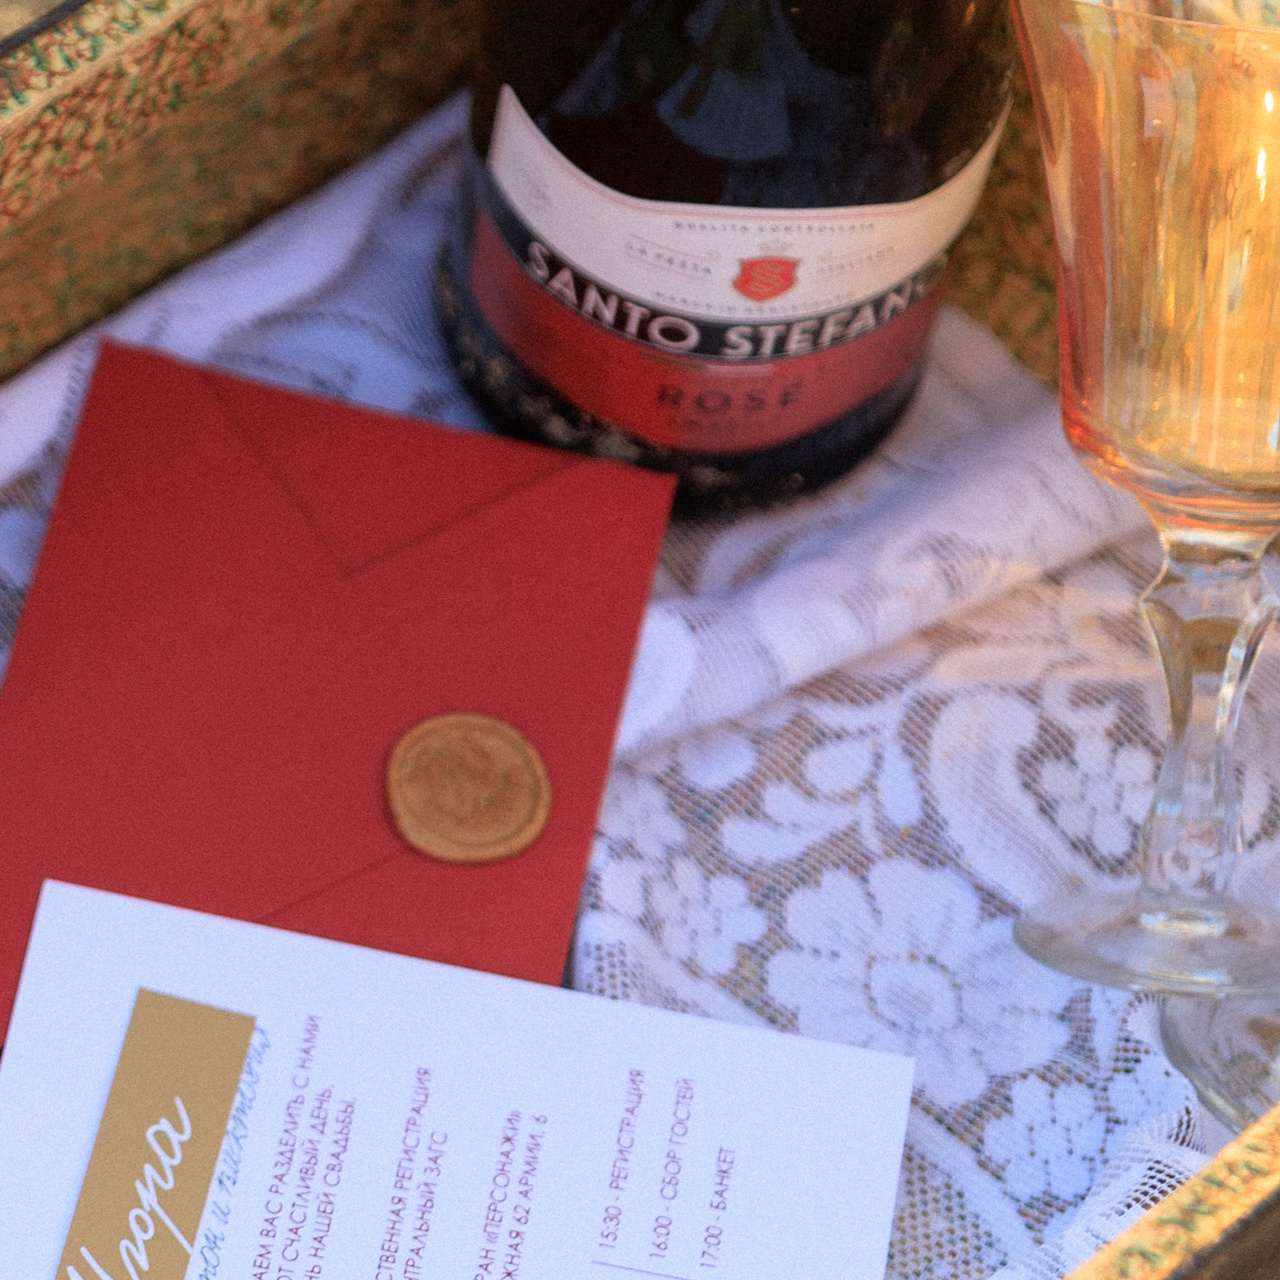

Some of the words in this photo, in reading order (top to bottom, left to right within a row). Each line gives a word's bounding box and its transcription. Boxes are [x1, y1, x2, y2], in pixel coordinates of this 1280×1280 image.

[527, 240, 700, 353] SANTO
[296, 1014, 320, 1070] НАМИ
[290, 1074, 310, 1089] С
[393, 1066, 432, 1190] РЕГИСТРАЦИЯ
[608, 1069, 646, 1191] РЕГИСТРАЦИЯ
[666, 1076, 696, 1146] ГОСТЕЙ
[268, 1094, 305, 1195] РАЗДЕЛИТЬ
[423, 1130, 448, 1176] ЗАГС
[279, 1137, 320, 1262] СЧАСТЛИВЫЙ
[659, 1150, 683, 1200] СБОР
[709, 1146, 736, 1210] БАНКЕТ
[260, 1200, 283, 1238] ВАС
[307, 1192, 336, 1258] НАШЕЙ
[512, 1204, 530, 1225] 62
[598, 1206, 622, 1248] 15:30
[649, 1214, 673, 1258] 16:00
[700, 1224, 723, 1268] 17:00
